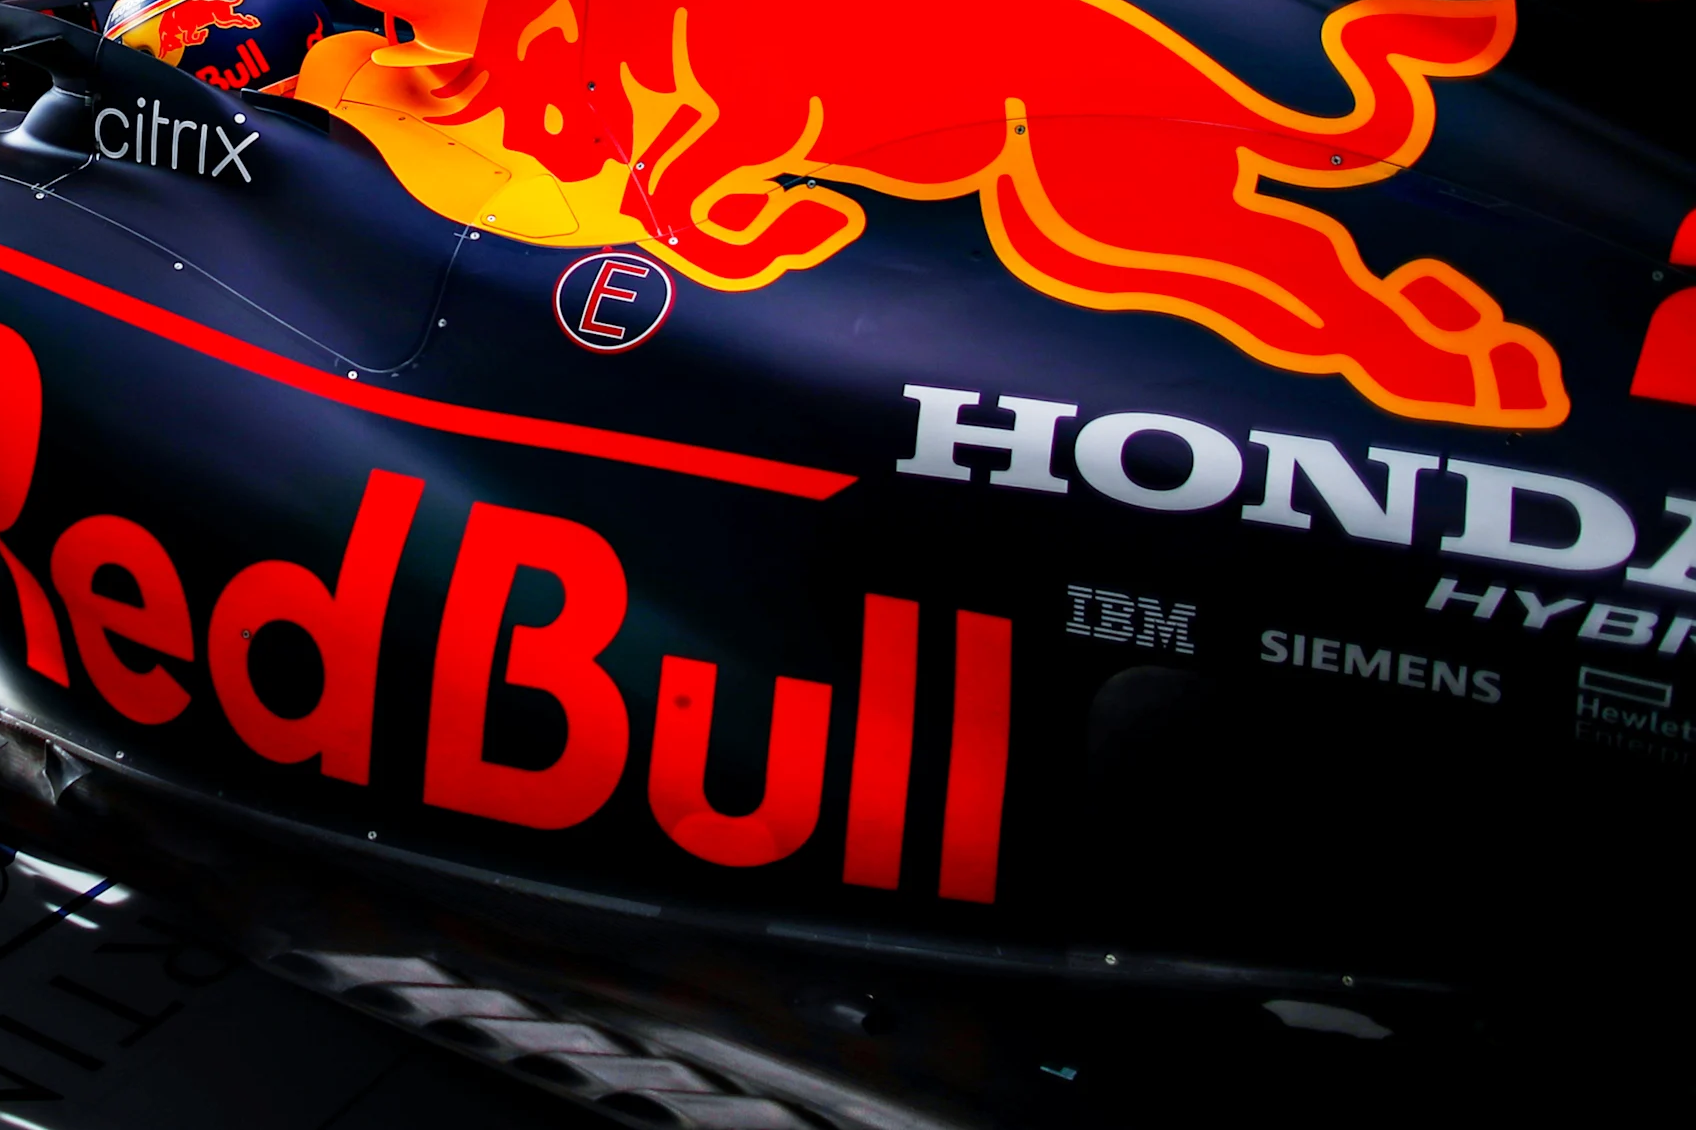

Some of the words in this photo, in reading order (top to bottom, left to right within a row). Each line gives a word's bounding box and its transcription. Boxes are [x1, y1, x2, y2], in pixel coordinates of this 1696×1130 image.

[94, 96, 261, 183] citrix
[1065, 583, 1197, 656] IBM
[421, 500, 1014, 905] Bull
[1259, 628, 1503, 707] SIEMENS
[1575, 693, 1696, 744] Hewlet
